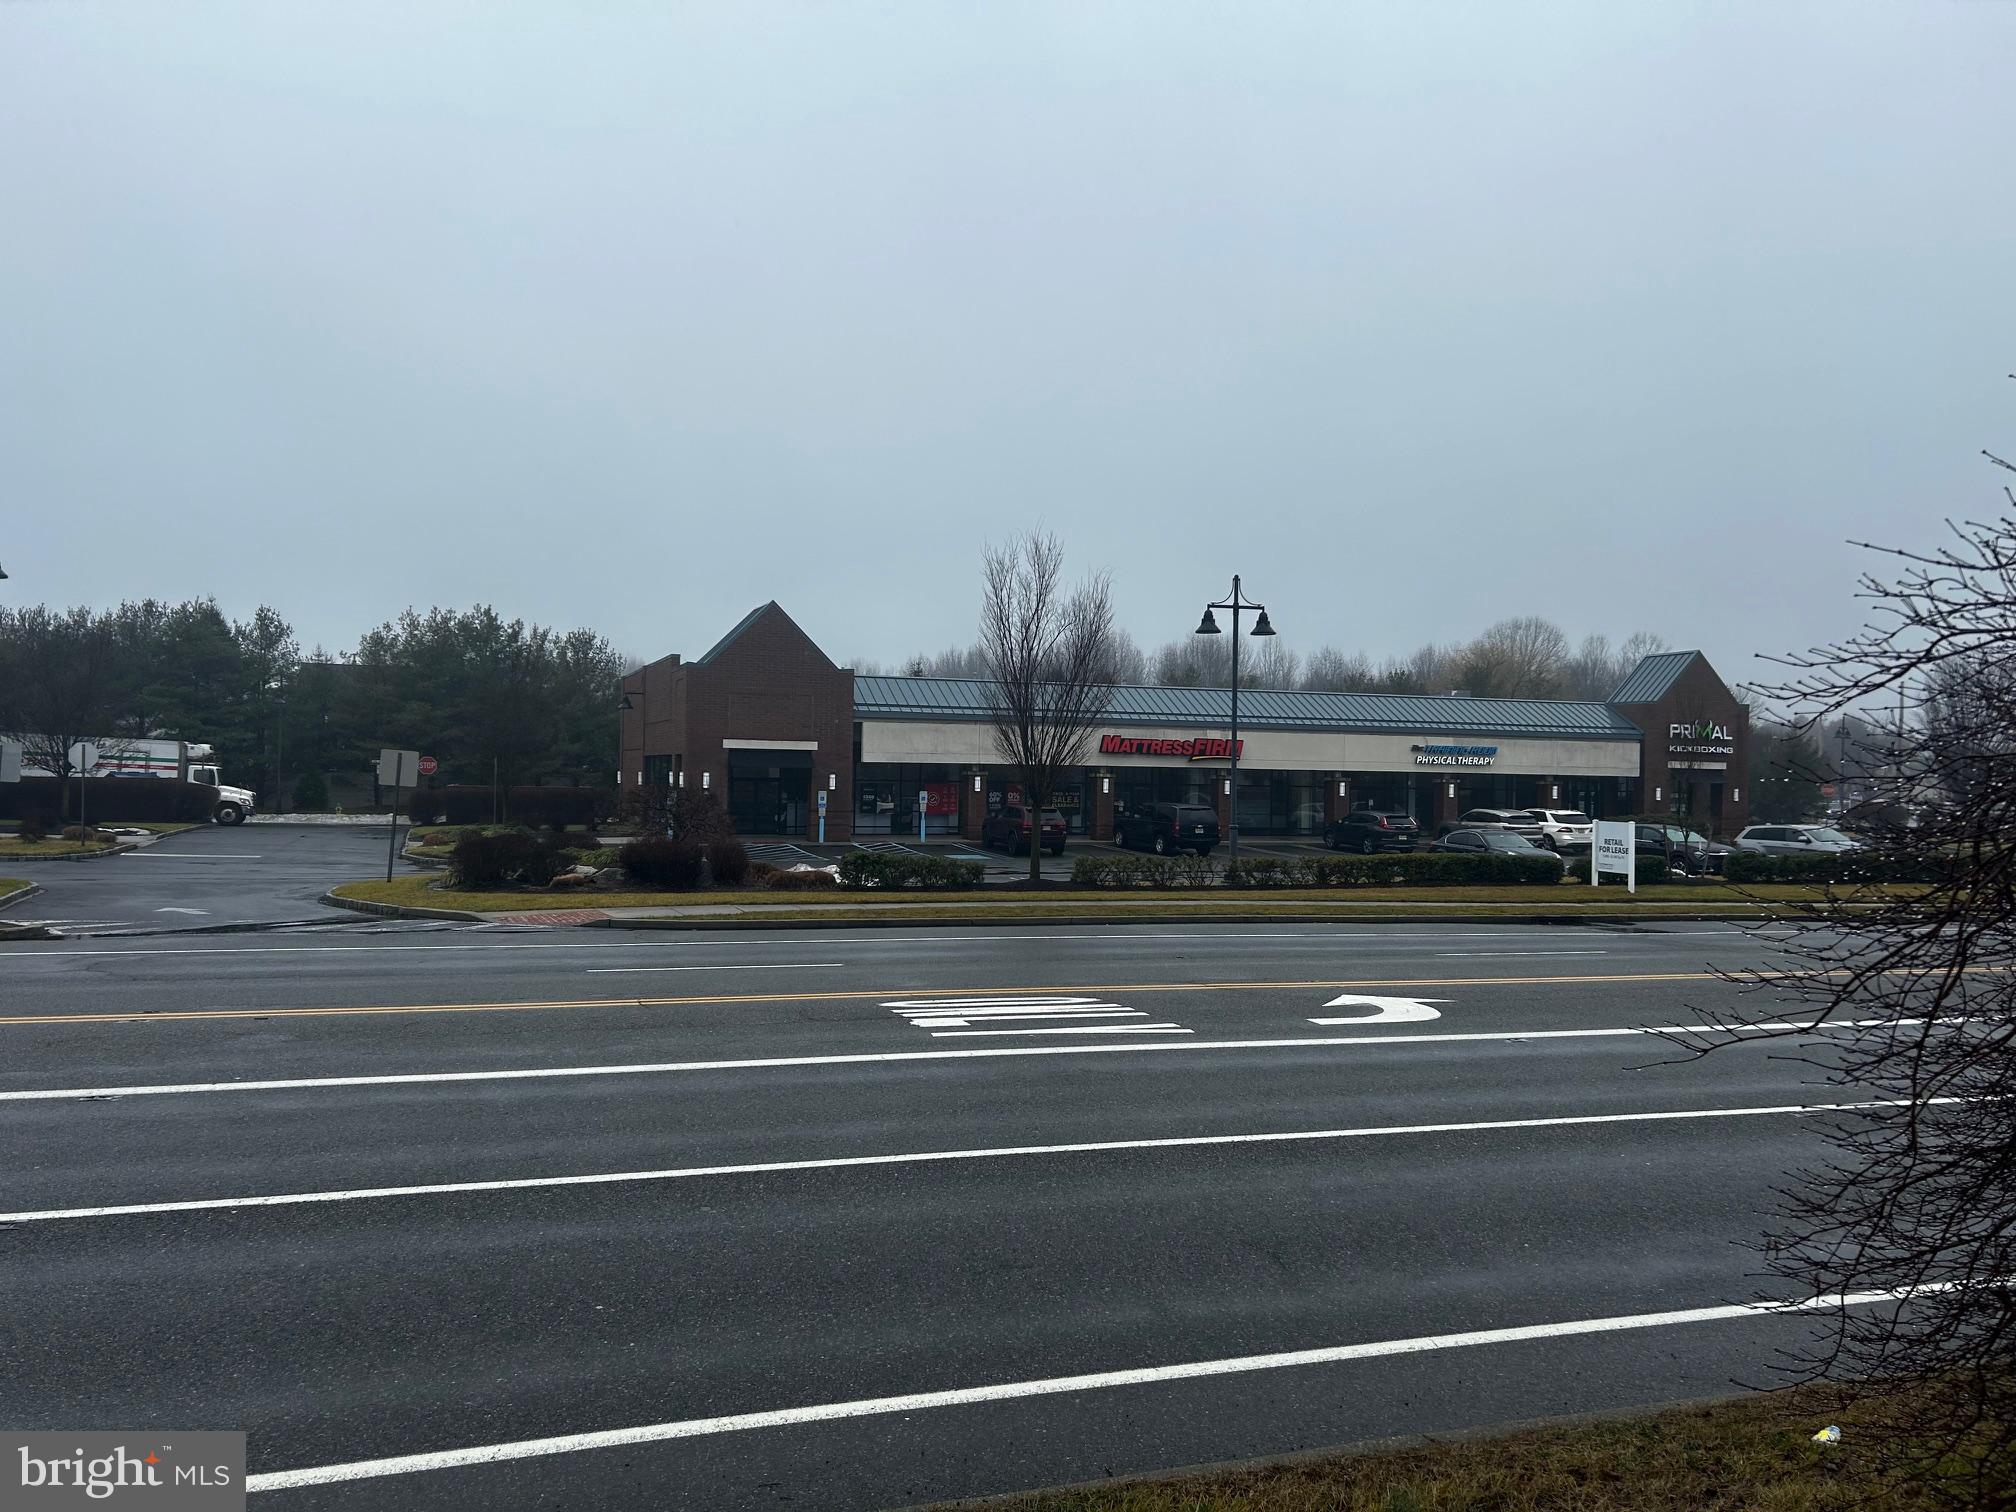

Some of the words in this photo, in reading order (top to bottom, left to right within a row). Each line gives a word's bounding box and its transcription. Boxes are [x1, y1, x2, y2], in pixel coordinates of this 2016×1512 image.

[1669, 720, 1733, 741] PRIMAL
[1669, 745, 1733, 754] KICKBOXING
[1416, 755, 1457, 765] PHYSICAL
[1457, 756, 1495, 766] THERAPY
[1611, 846, 1629, 854] LEASE
